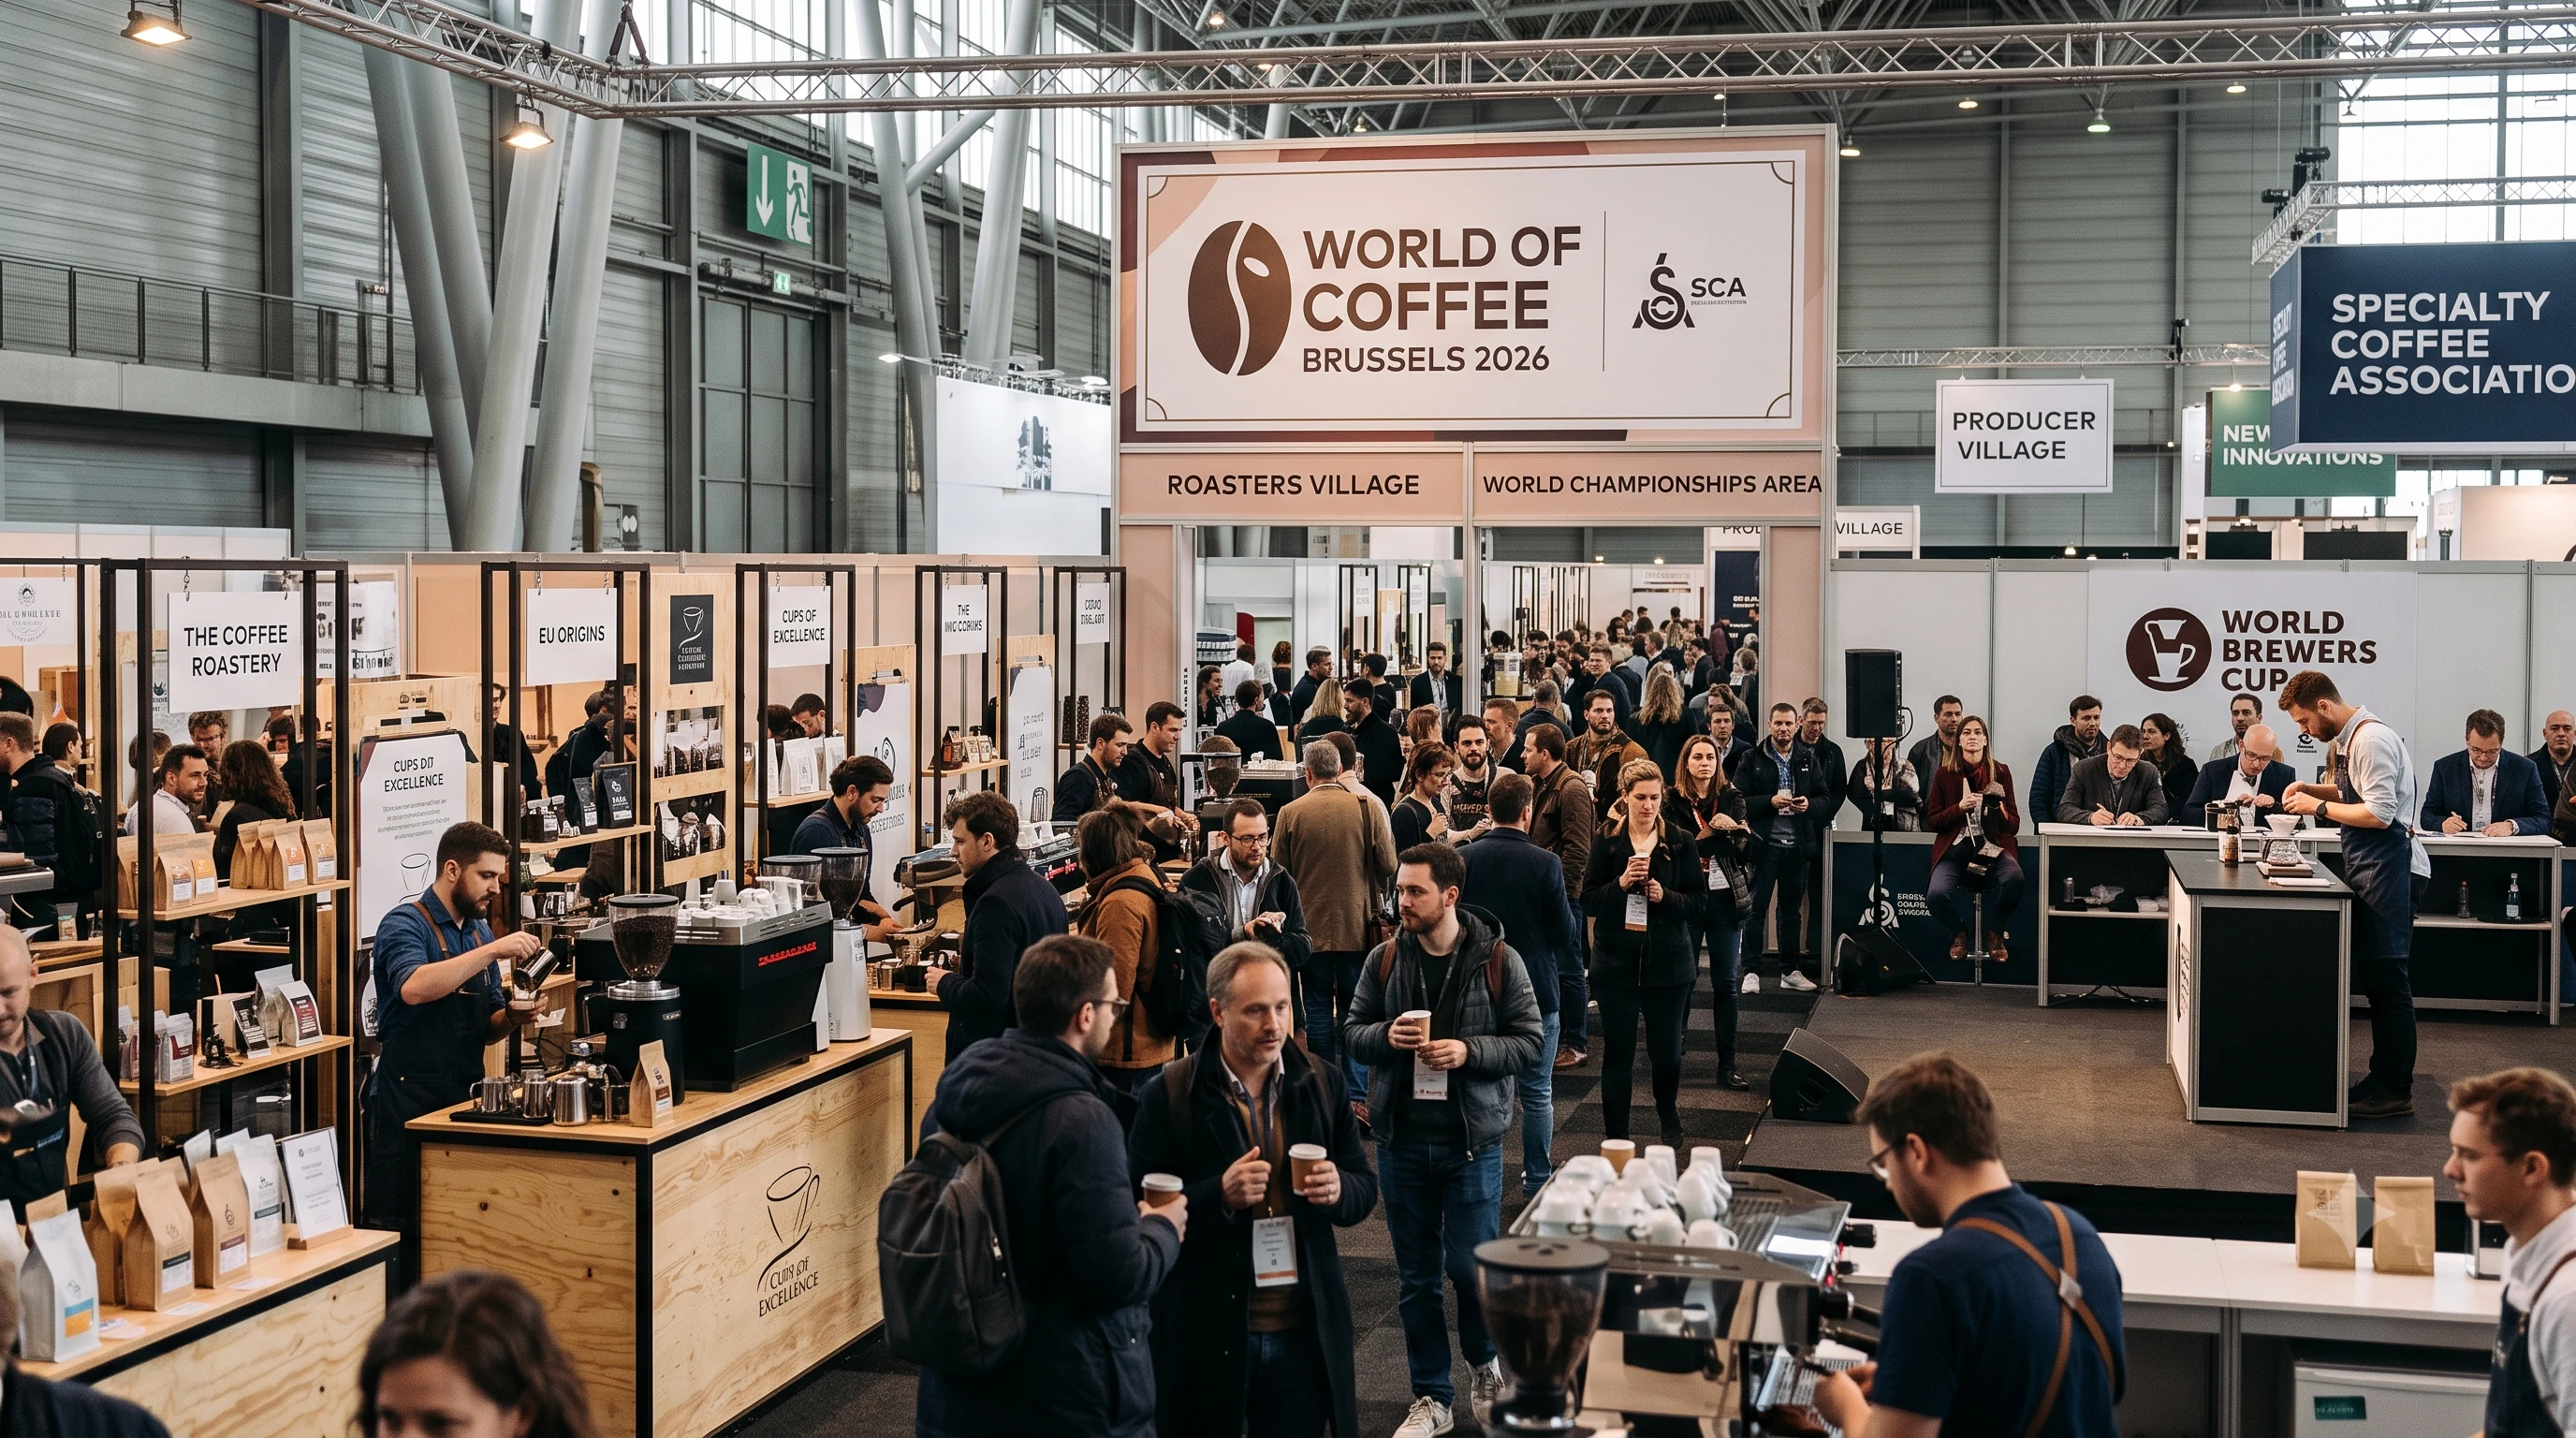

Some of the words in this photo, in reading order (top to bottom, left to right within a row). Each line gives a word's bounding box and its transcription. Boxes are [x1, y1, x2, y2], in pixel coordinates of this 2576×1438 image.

[1302, 227, 1497, 270] WORLD
[1511, 226, 1581, 268] OF
[1690, 277, 1747, 298] SCA
[1302, 280, 1549, 332] COFFEE
[2332, 290, 2551, 323] SPECIALTY
[2331, 328, 2490, 360] COFFEE
[1303, 345, 1466, 373] BRUSSELS
[1474, 345, 1550, 373] 2026
[2329, 363, 2576, 395] ASSOCIATIO
[1953, 411, 2096, 431] PRODUCER
[2223, 424, 2271, 443] NEW
[1957, 440, 2066, 460] VILLAGE
[2223, 448, 2383, 465] INNOVATIONS
[1168, 474, 1302, 495] ROASTERS
[1309, 474, 1420, 495] VILLAGE
[1483, 476, 1564, 493] WORLD
[1570, 475, 1757, 493] CHAMPIONSHIPS
[1762, 475, 1822, 493] AREA
[1836, 521, 1903, 535] VILLAGE
[783, 609, 804, 624] CUPS
[805, 609, 817, 623] OF
[2221, 609, 2345, 635] WORLD
[183, 626, 218, 647] THE
[223, 624, 288, 646] COFFEE
[539, 627, 555, 644] EU
[558, 625, 605, 643] ORIGINS
[773, 627, 826, 644] EXCELLENCE
[2222, 638, 2378, 665] BREWERS
[192, 653, 282, 677] ROASTERY
[2220, 668, 2290, 693] CUP
[393, 758, 418, 773] CUPS
[384, 773, 444, 793] EXCELLENCE
[759, 1270, 819, 1318] EXCELLENCE
